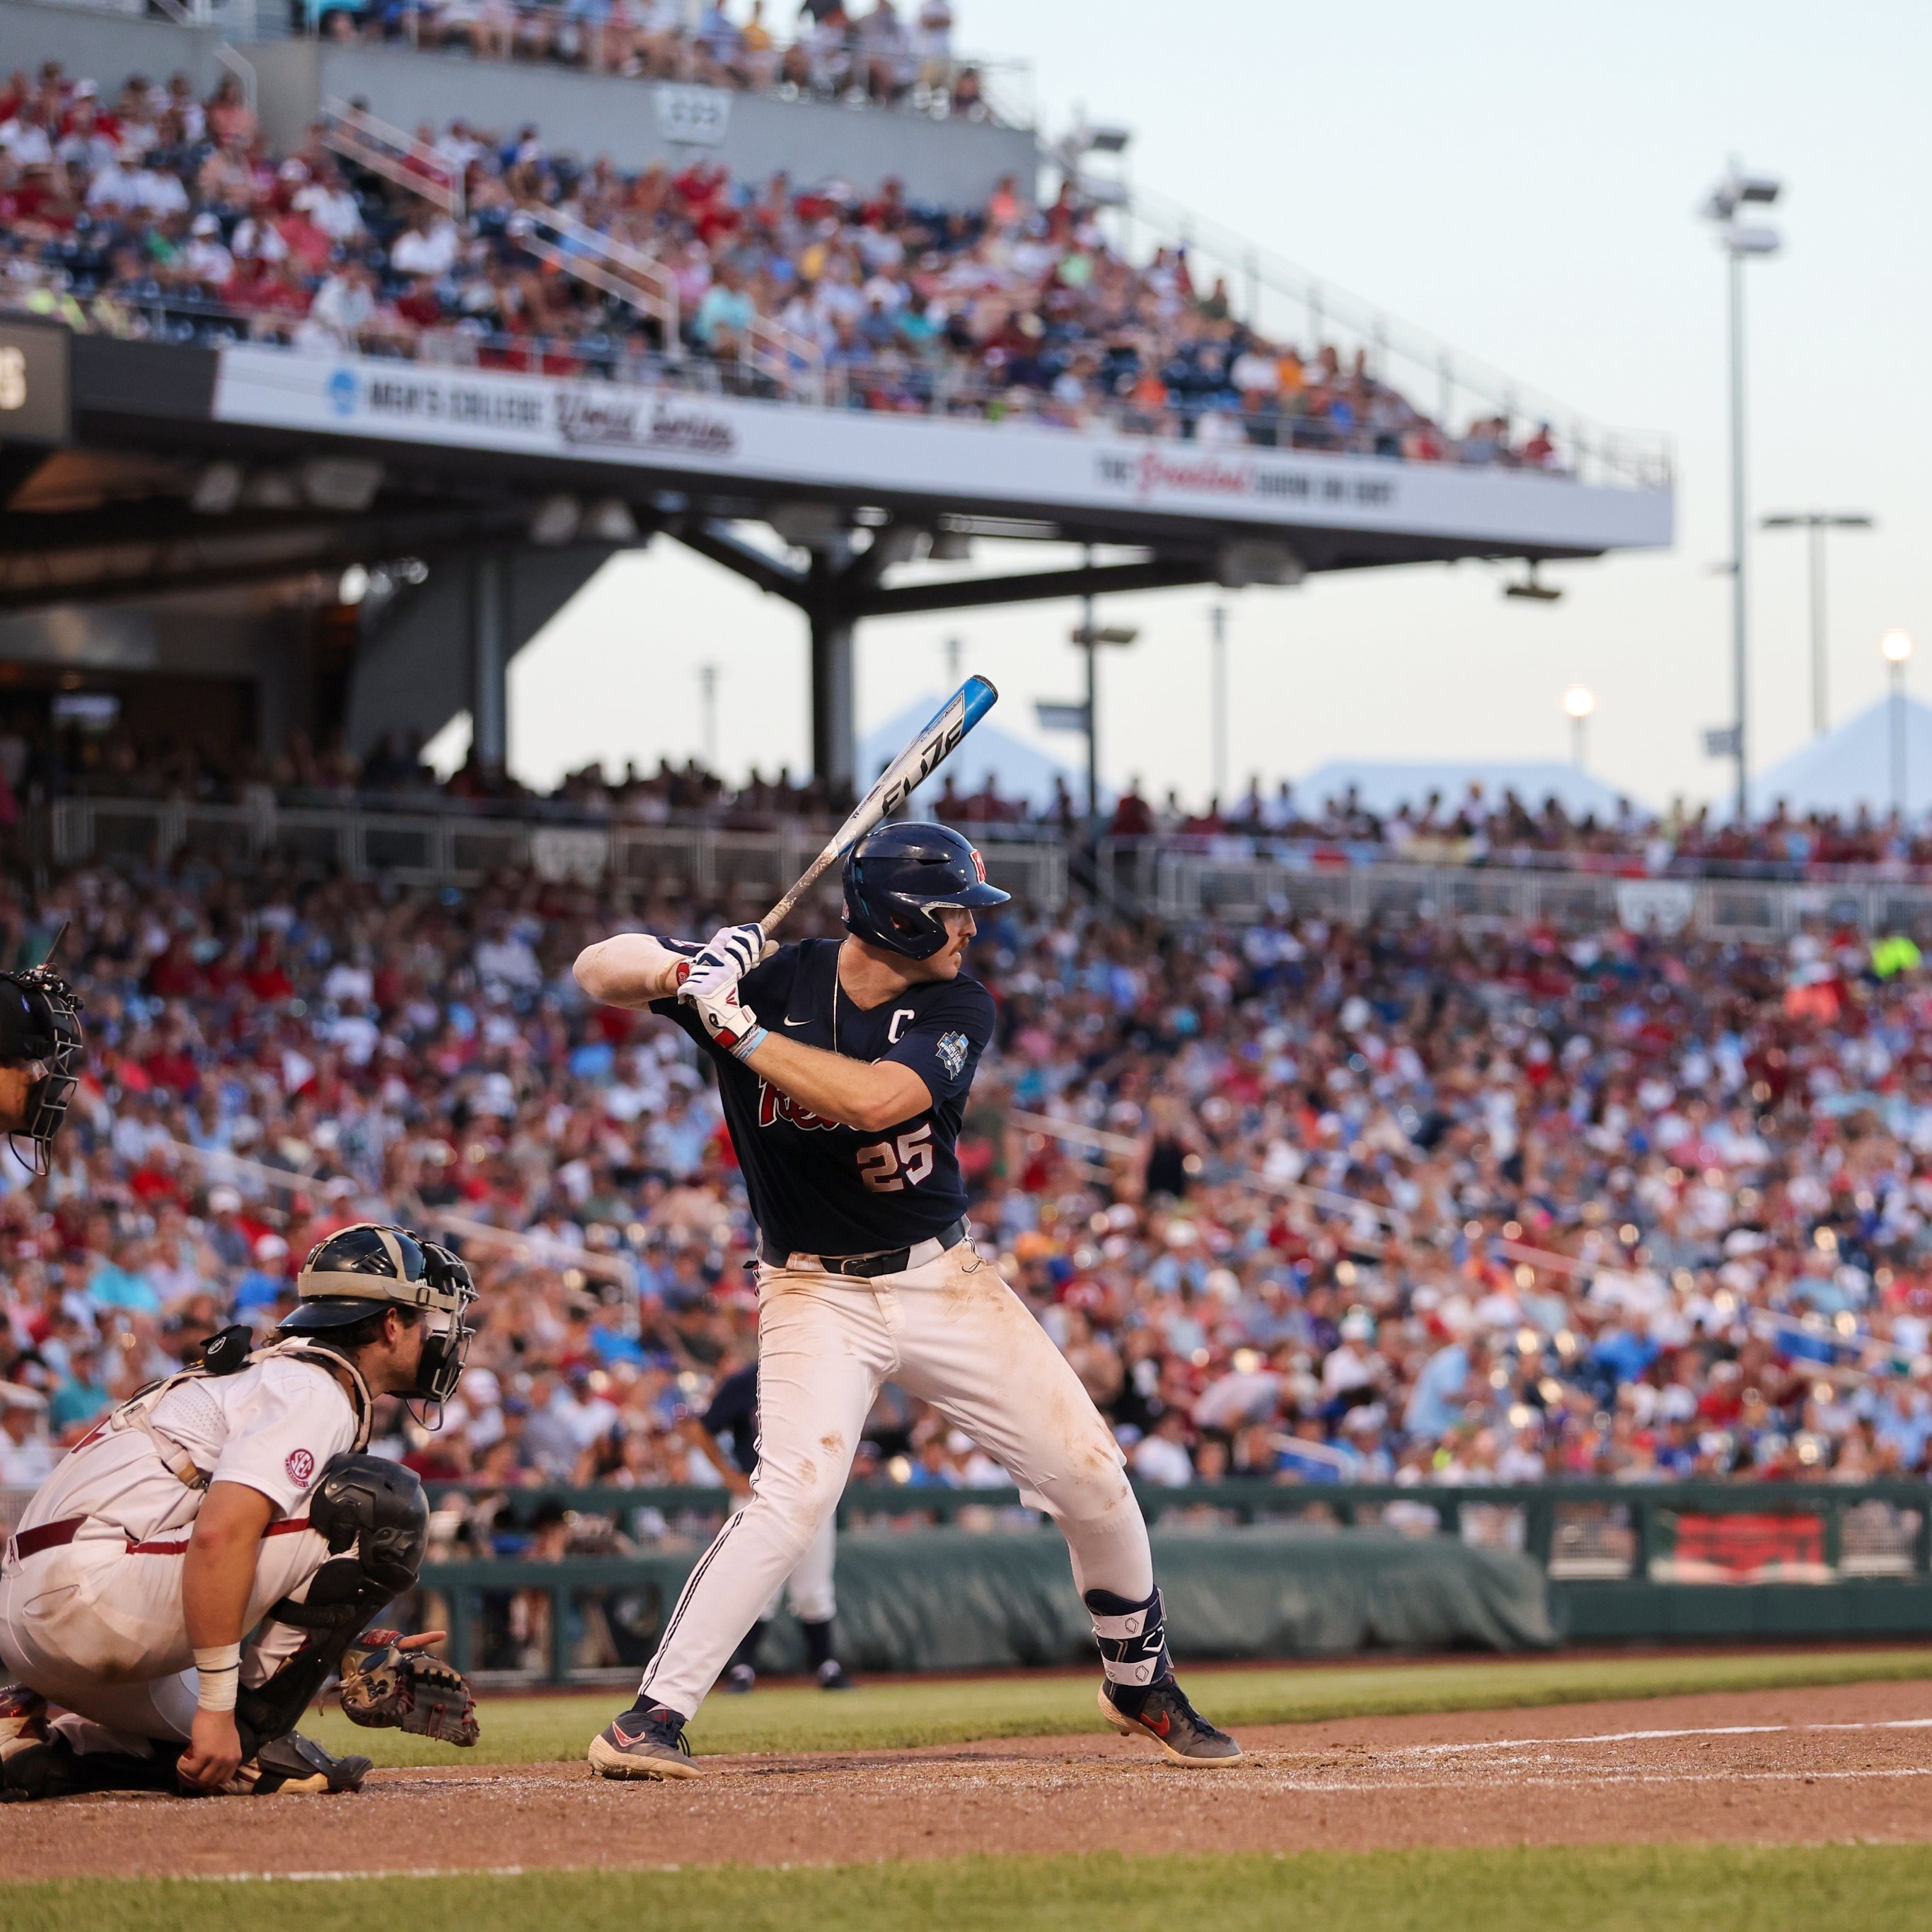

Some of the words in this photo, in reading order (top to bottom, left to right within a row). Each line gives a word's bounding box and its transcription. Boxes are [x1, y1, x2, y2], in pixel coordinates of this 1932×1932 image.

[887, 1008, 915, 1044] C
[939, 1041, 954, 1058] WORLD
[951, 1056, 961, 1073] SERIES
[948, 1043, 962, 1062] COLLEGE
[855, 1122, 934, 1193] 25
[291, 1451, 312, 1479] SEC
